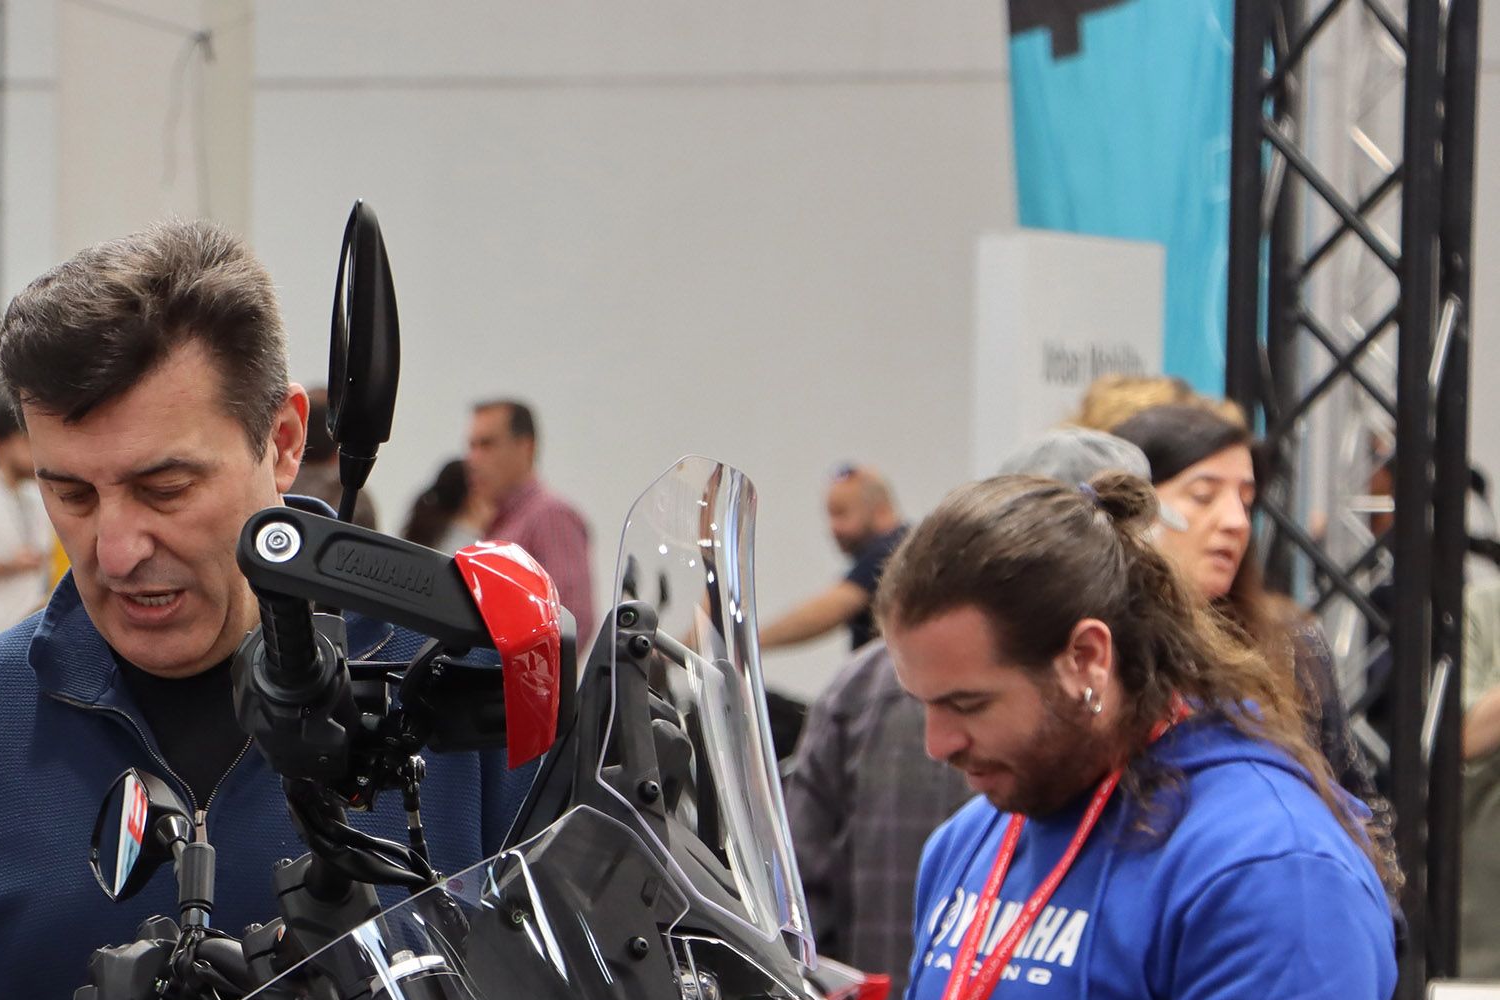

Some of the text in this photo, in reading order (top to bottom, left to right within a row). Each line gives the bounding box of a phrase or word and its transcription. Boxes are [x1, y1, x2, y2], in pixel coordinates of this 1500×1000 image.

[334, 545, 436, 597] YAMAHA
[948, 891, 1090, 968] YAMHA
[924, 950, 1053, 986] ANG
